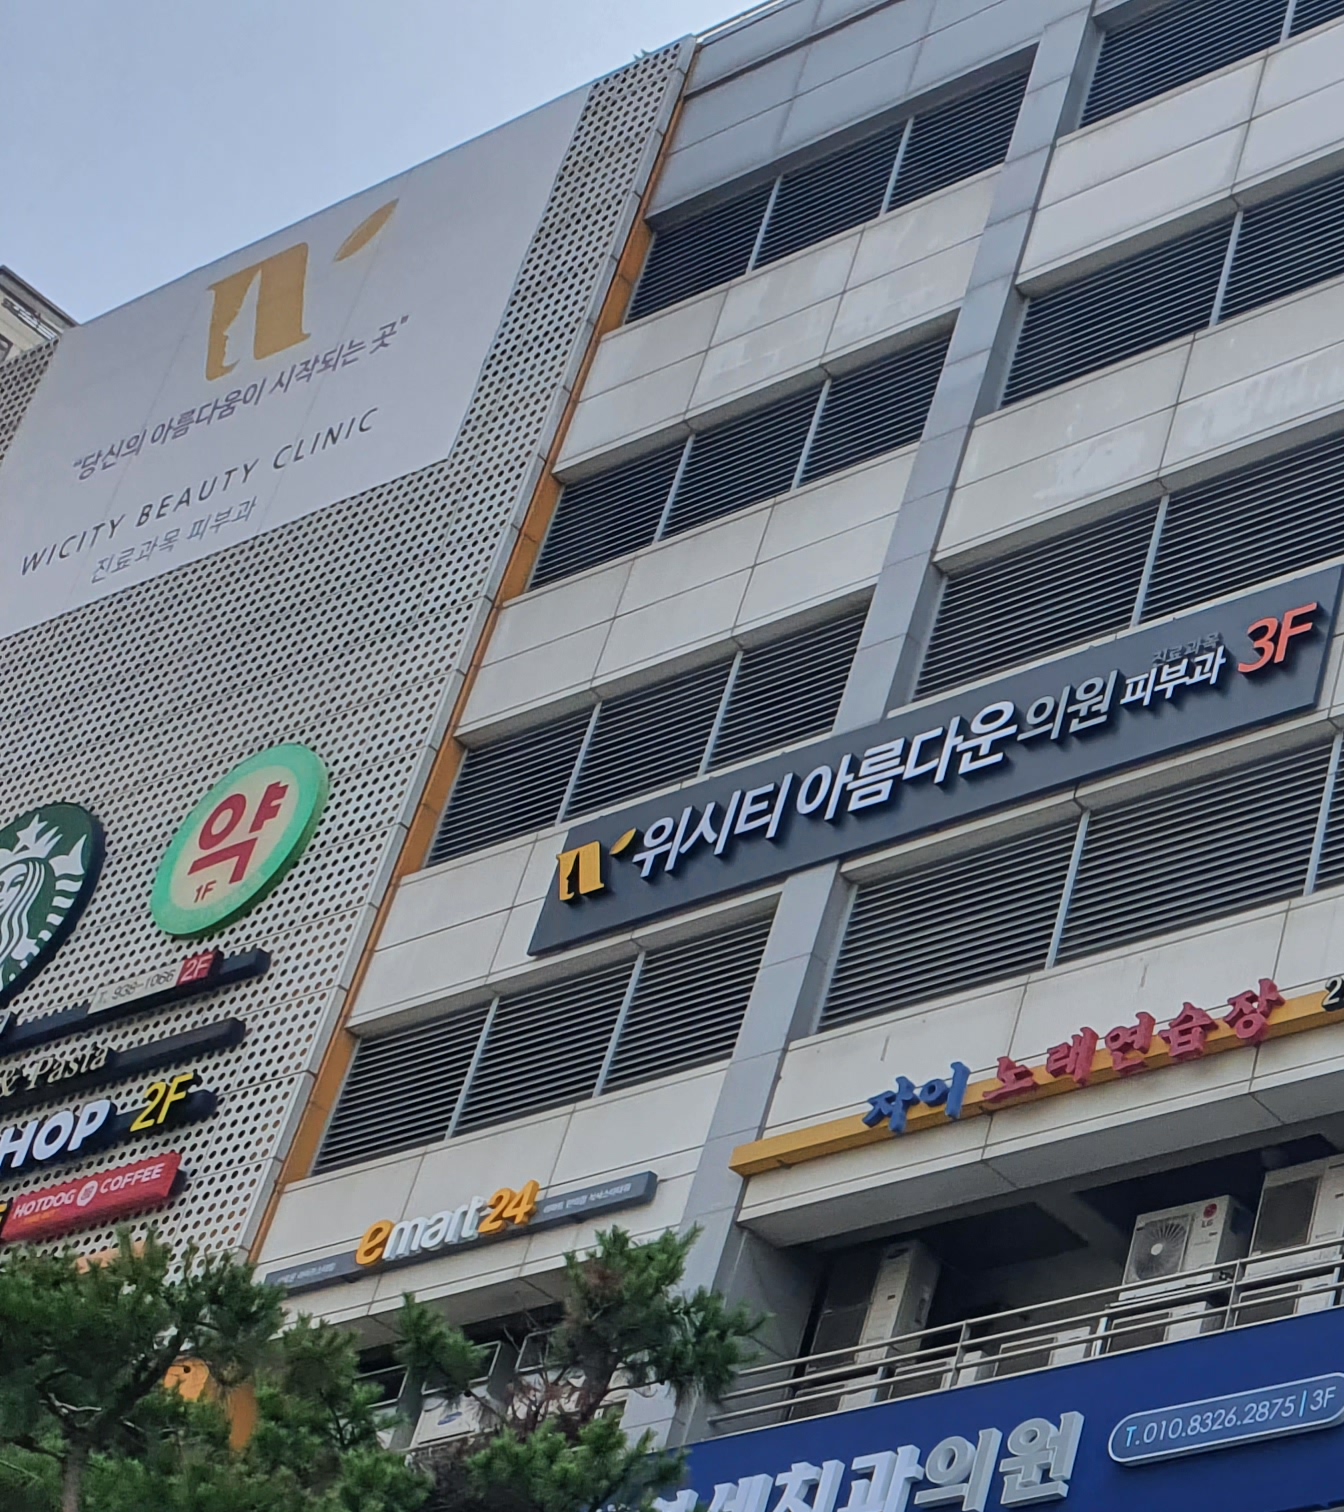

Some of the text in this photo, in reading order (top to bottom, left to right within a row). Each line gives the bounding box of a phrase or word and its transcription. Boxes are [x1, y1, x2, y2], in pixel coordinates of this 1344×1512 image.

[21, 407, 379, 576] WICITY BEAUTY CLINIC
[92, 495, 258, 585] 진료과목 피부과
[1237, 602, 1318, 673] 3F
[632, 772, 796, 879] 위시티
[1120, 645, 1226, 706] 피부과
[188, 780, 289, 885] 약
[180, 954, 214, 984] 2F
[21, 1045, 109, 1091] Pasta
[982, 976, 1286, 1104] 노래연습장
[130, 1073, 194, 1132] 2F
[100, 1162, 166, 1195] COFFEE
[355, 1179, 541, 1267] emart24
